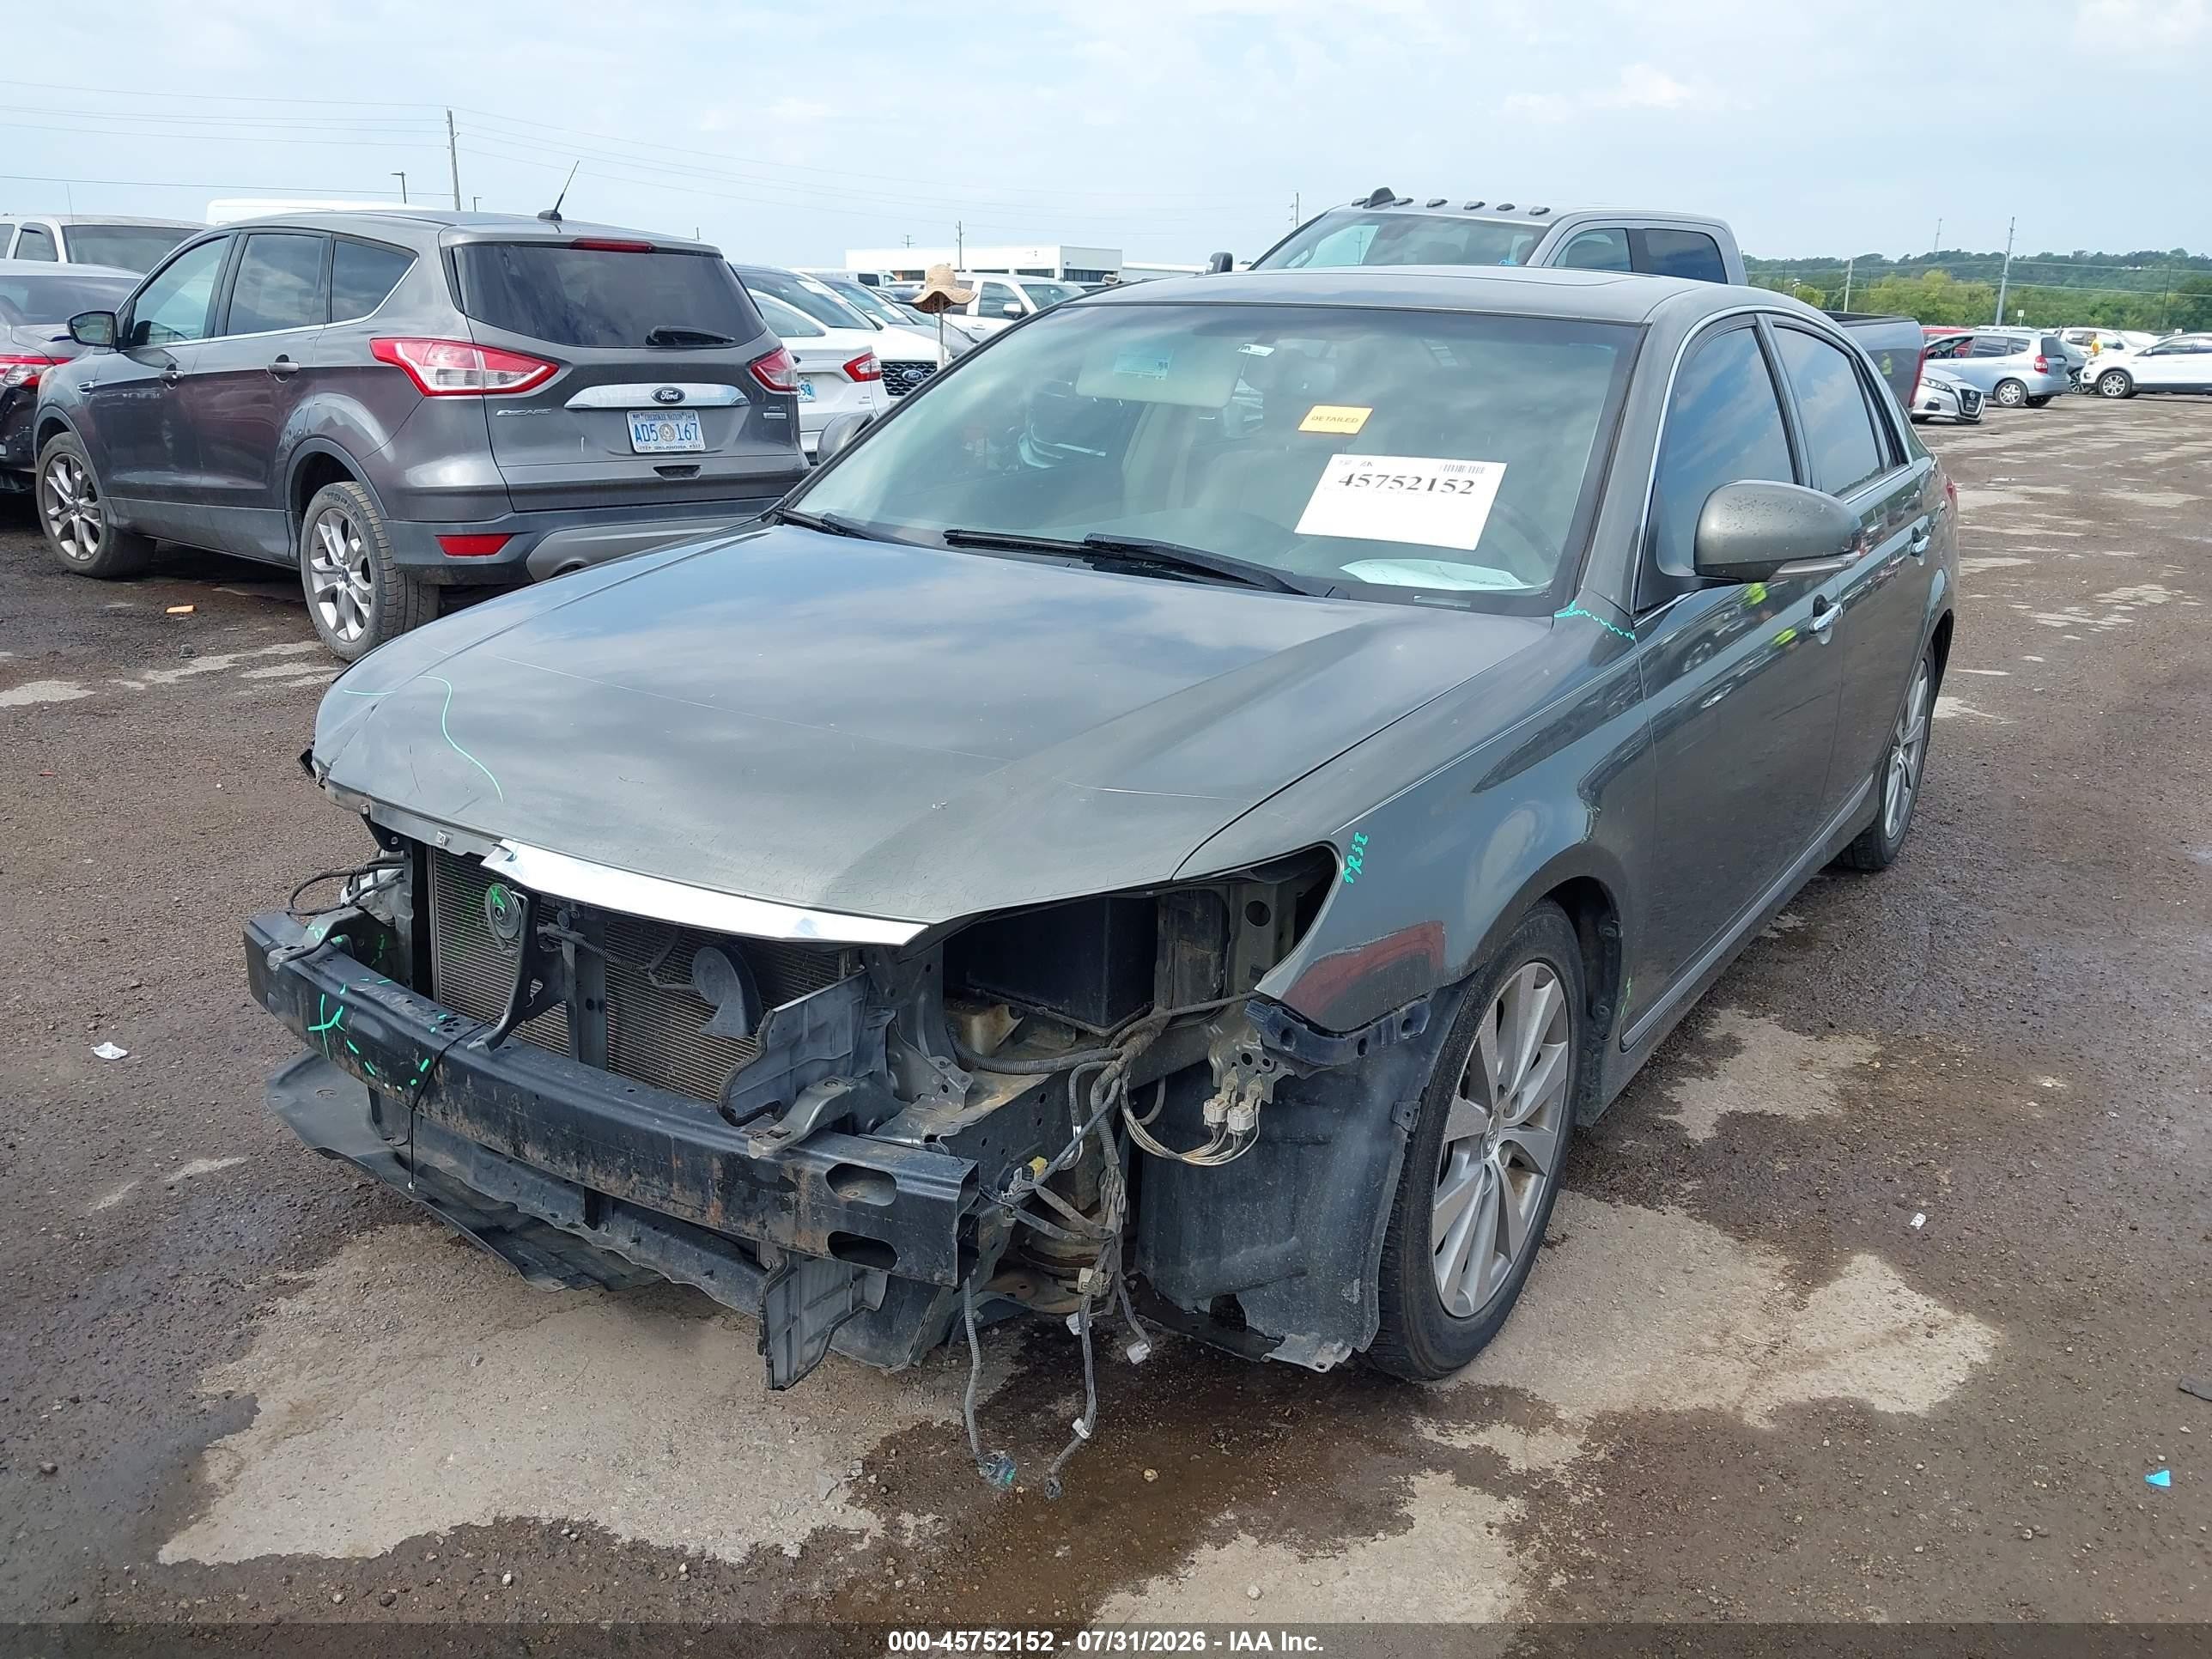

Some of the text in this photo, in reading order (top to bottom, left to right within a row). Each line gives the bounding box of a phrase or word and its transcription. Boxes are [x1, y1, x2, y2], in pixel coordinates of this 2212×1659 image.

[660, 390, 679, 400] Ford
[1310, 415, 1358, 423] DETAILED
[635, 422, 697, 442] AD5 167
[1338, 472, 1475, 495] 45752152
